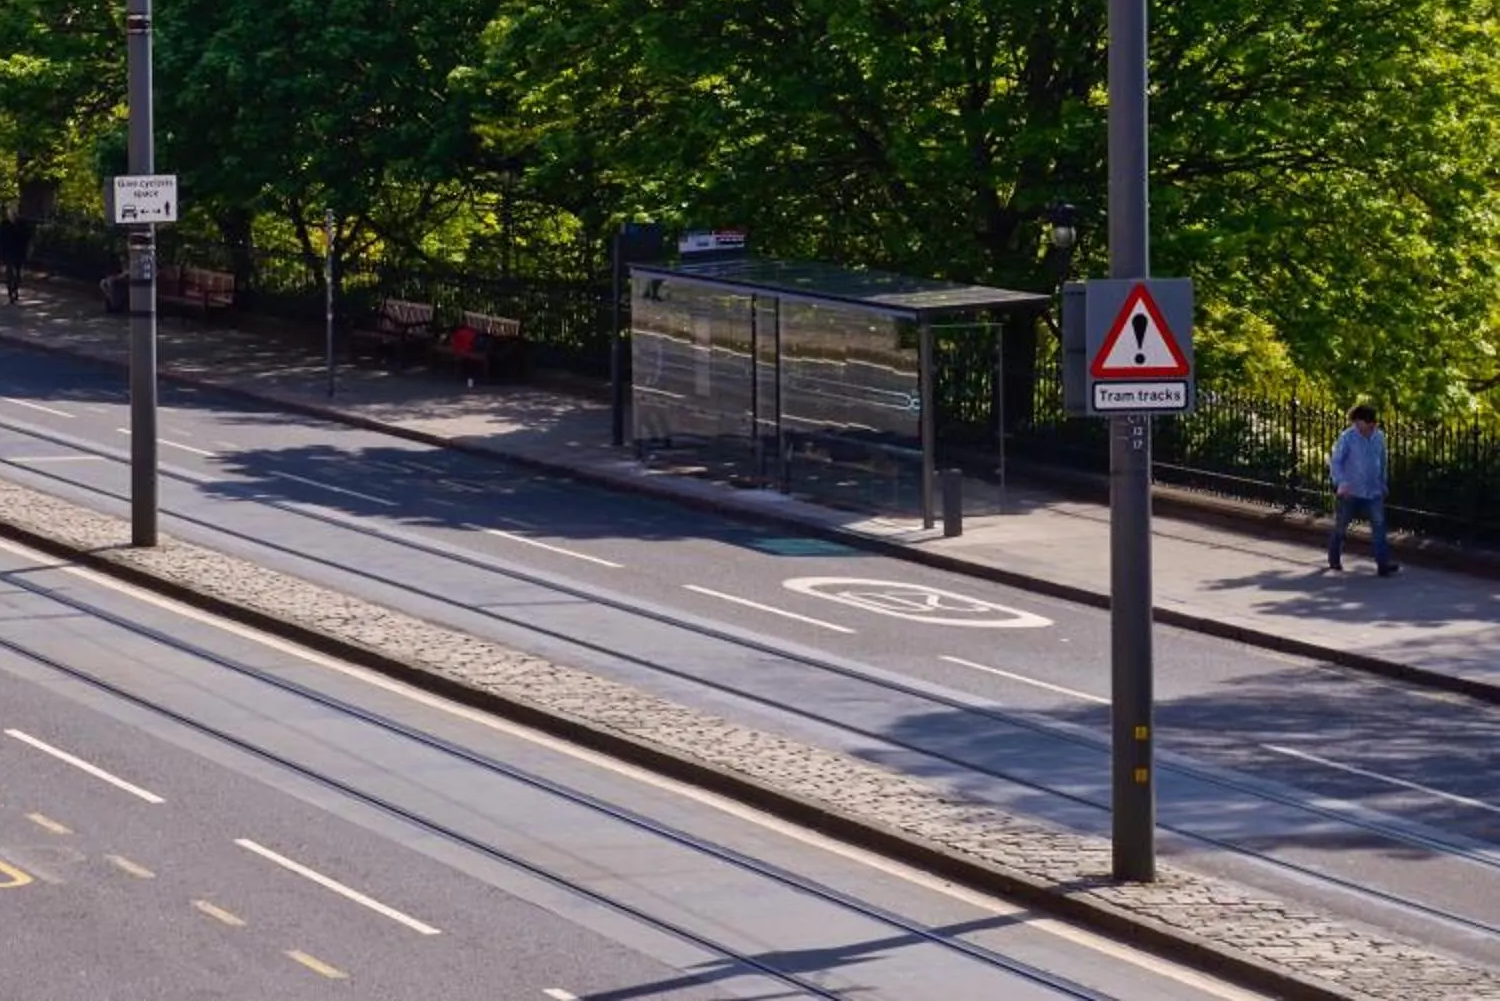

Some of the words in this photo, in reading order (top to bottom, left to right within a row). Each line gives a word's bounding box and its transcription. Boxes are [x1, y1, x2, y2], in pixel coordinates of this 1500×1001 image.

[133, 190, 159, 199] space
[1100, 389, 1135, 401] Tram
[1138, 388, 1181, 401] tracks
